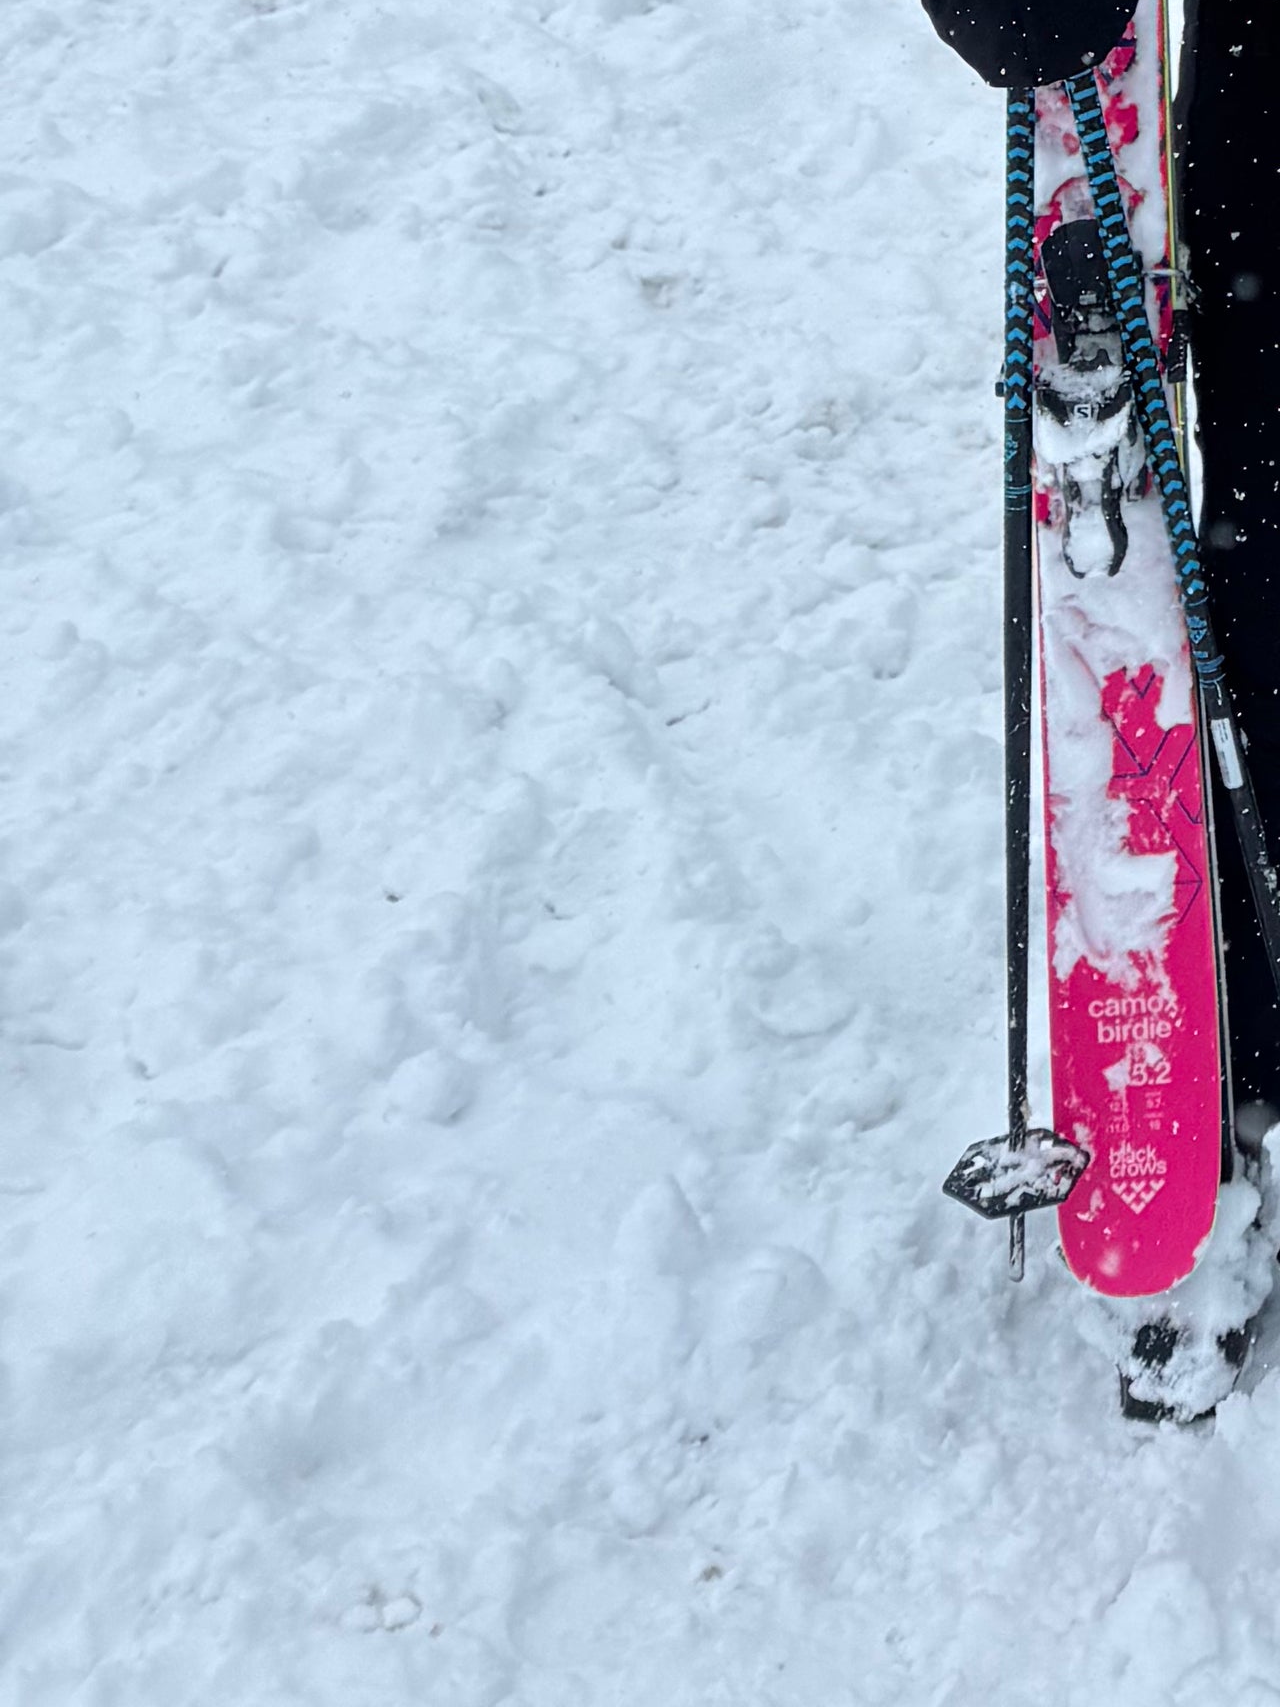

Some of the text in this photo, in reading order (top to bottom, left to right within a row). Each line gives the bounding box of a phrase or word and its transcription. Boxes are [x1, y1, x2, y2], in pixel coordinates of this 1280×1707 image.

[1097, 1017, 1172, 1044] birdie
[1109, 1143, 1156, 1165] black
[1110, 1160, 1167, 1178] crows
